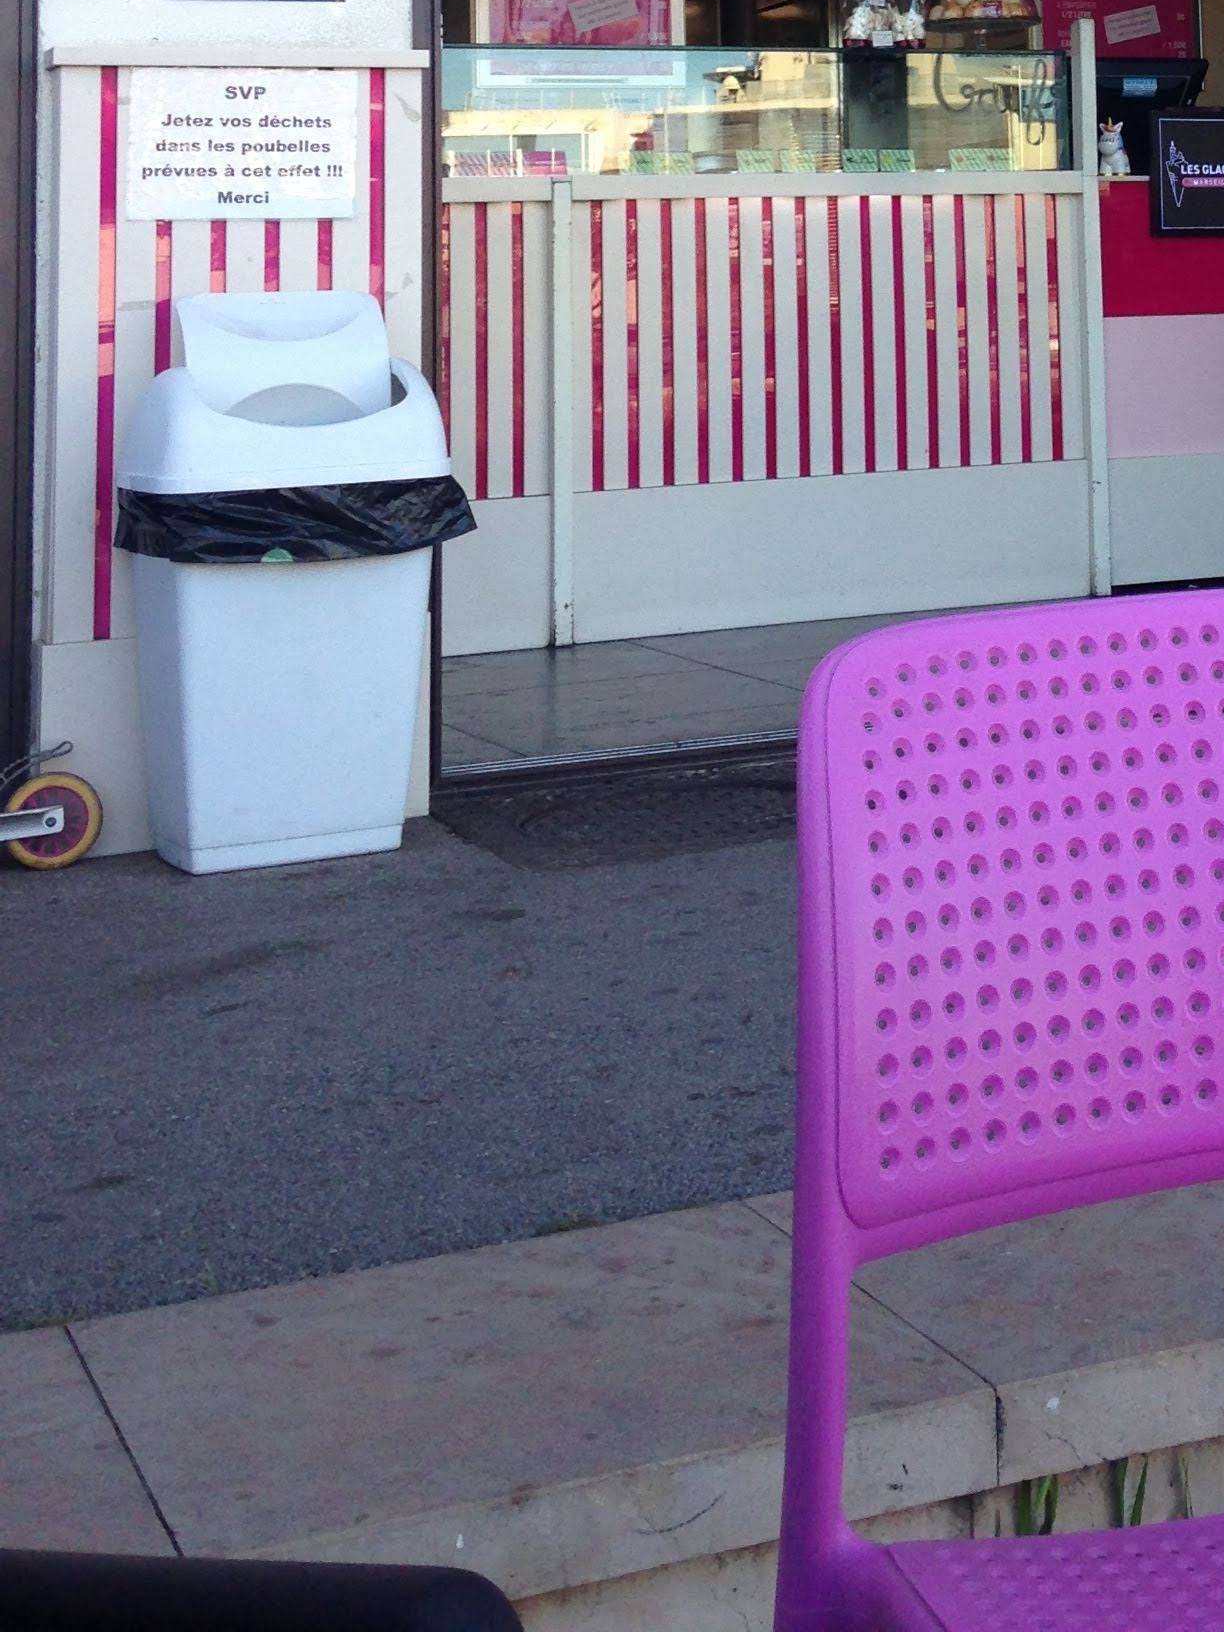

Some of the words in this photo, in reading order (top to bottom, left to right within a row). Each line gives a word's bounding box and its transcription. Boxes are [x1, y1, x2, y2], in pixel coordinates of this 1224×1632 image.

[224, 85, 267, 100] SVP
[161, 113, 214, 128] Jetez
[219, 116, 252, 128] vos
[258, 114, 332, 129] déchets
[155, 139, 201, 152] dans
[208, 139, 235, 152] les
[241, 139, 331, 156] poubelles
[141, 164, 218, 180] prévues
[223, 164, 236, 177] à
[241, 165, 272, 178] cet
[277, 164, 321, 178] effet
[326, 164, 343, 178] !!!
[1180, 164, 1200, 175] LES
[217, 190, 270, 204] Merci
